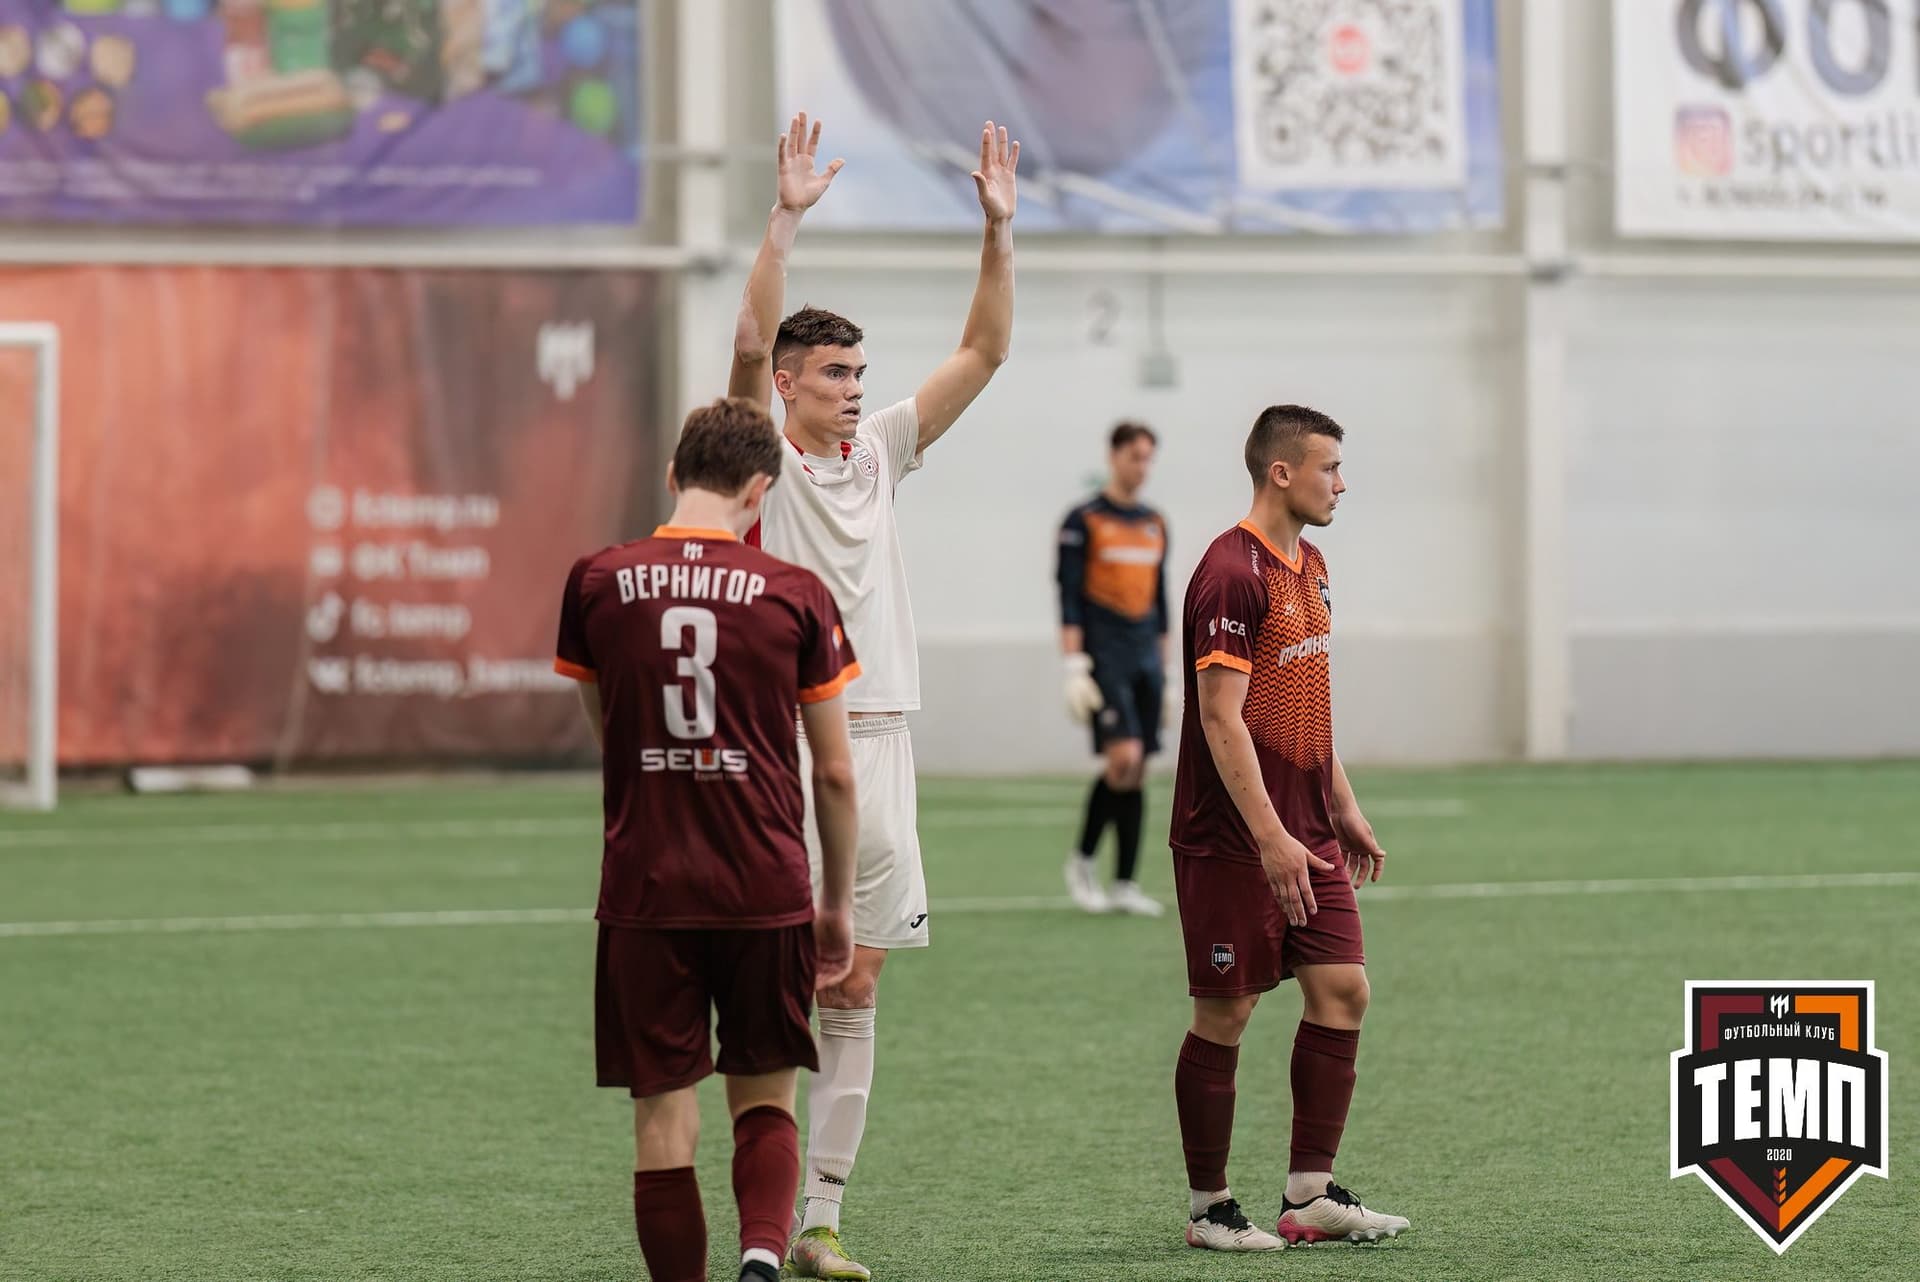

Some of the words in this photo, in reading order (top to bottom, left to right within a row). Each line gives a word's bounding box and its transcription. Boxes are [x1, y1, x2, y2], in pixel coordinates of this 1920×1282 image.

[616, 564, 767, 605] ВЕРНИГОР
[1221, 616, 1246, 636] ПСБ
[660, 605, 718, 740] 3
[641, 748, 748, 772] SEUS
[1214, 952, 1232, 963] ТЕМП
